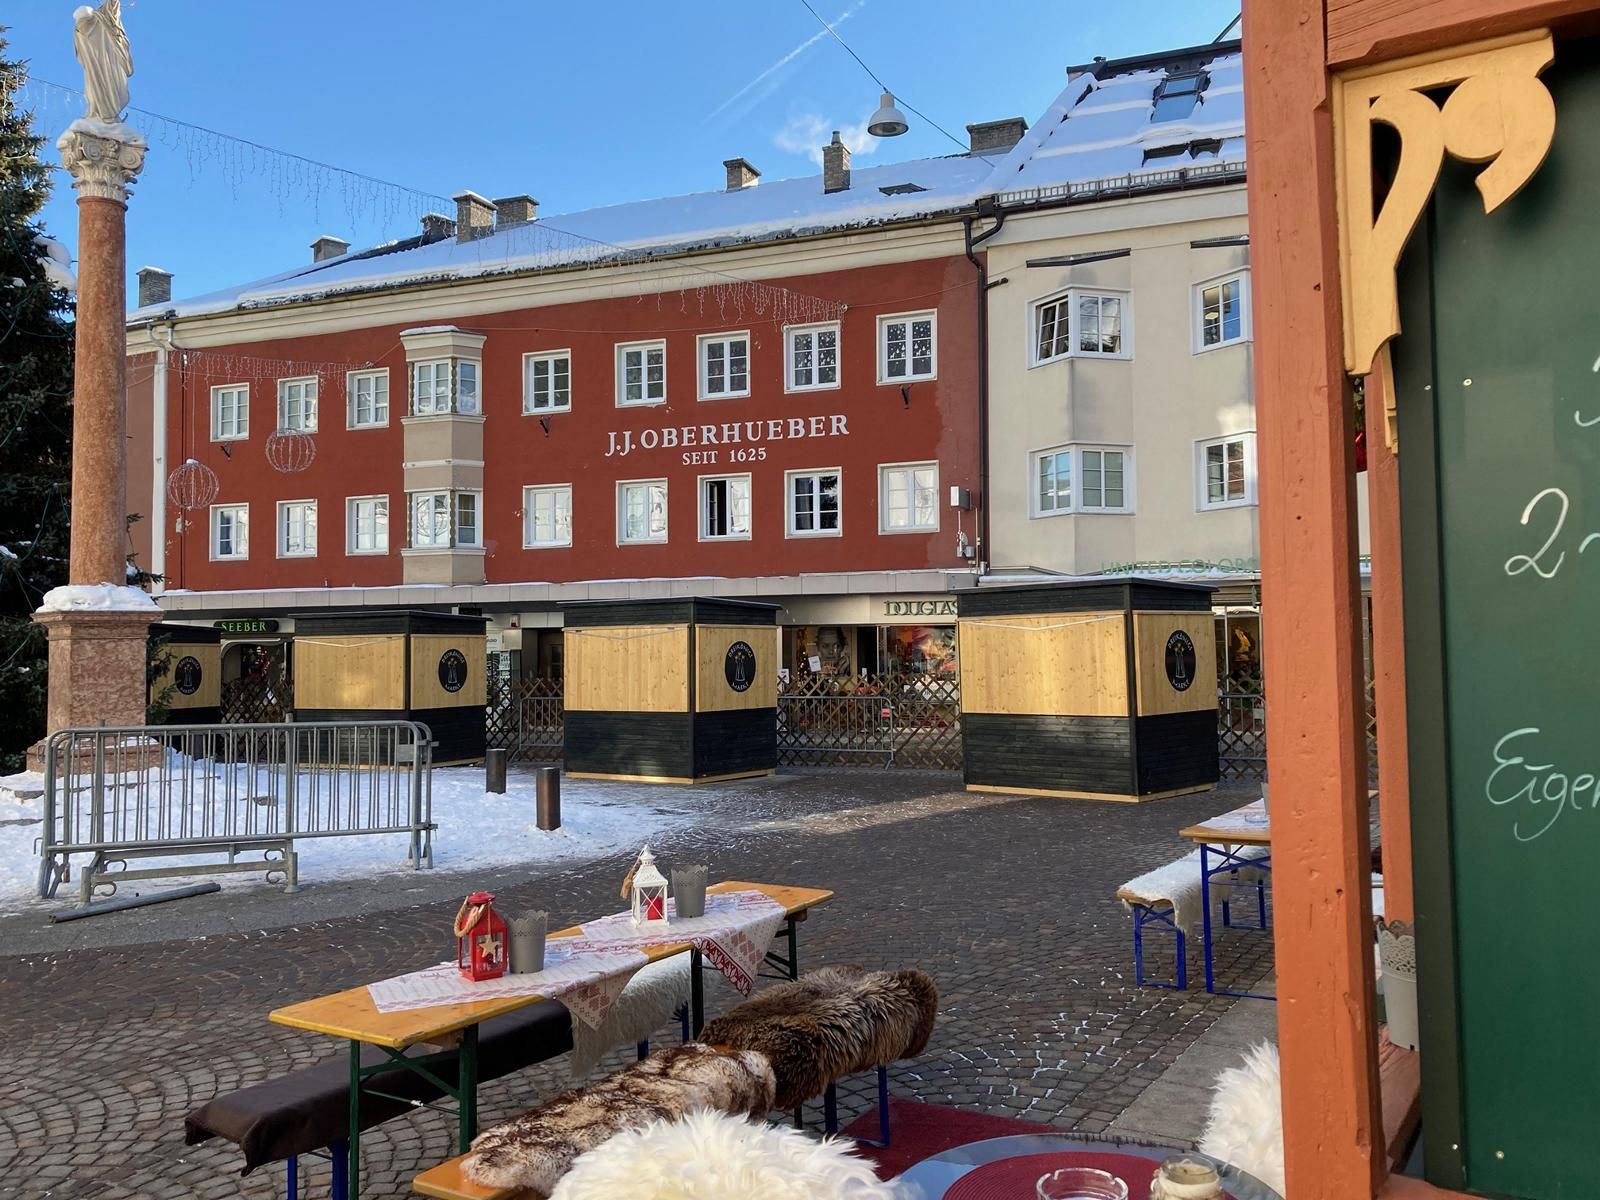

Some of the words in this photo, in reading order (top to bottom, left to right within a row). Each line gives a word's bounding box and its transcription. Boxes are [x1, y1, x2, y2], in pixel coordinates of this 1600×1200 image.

[682, 450, 718, 466] SEIT
[729, 447, 767, 463] 1625
[1101, 559, 1172, 576] UNITED
[221, 622, 267, 632] SEEBER
